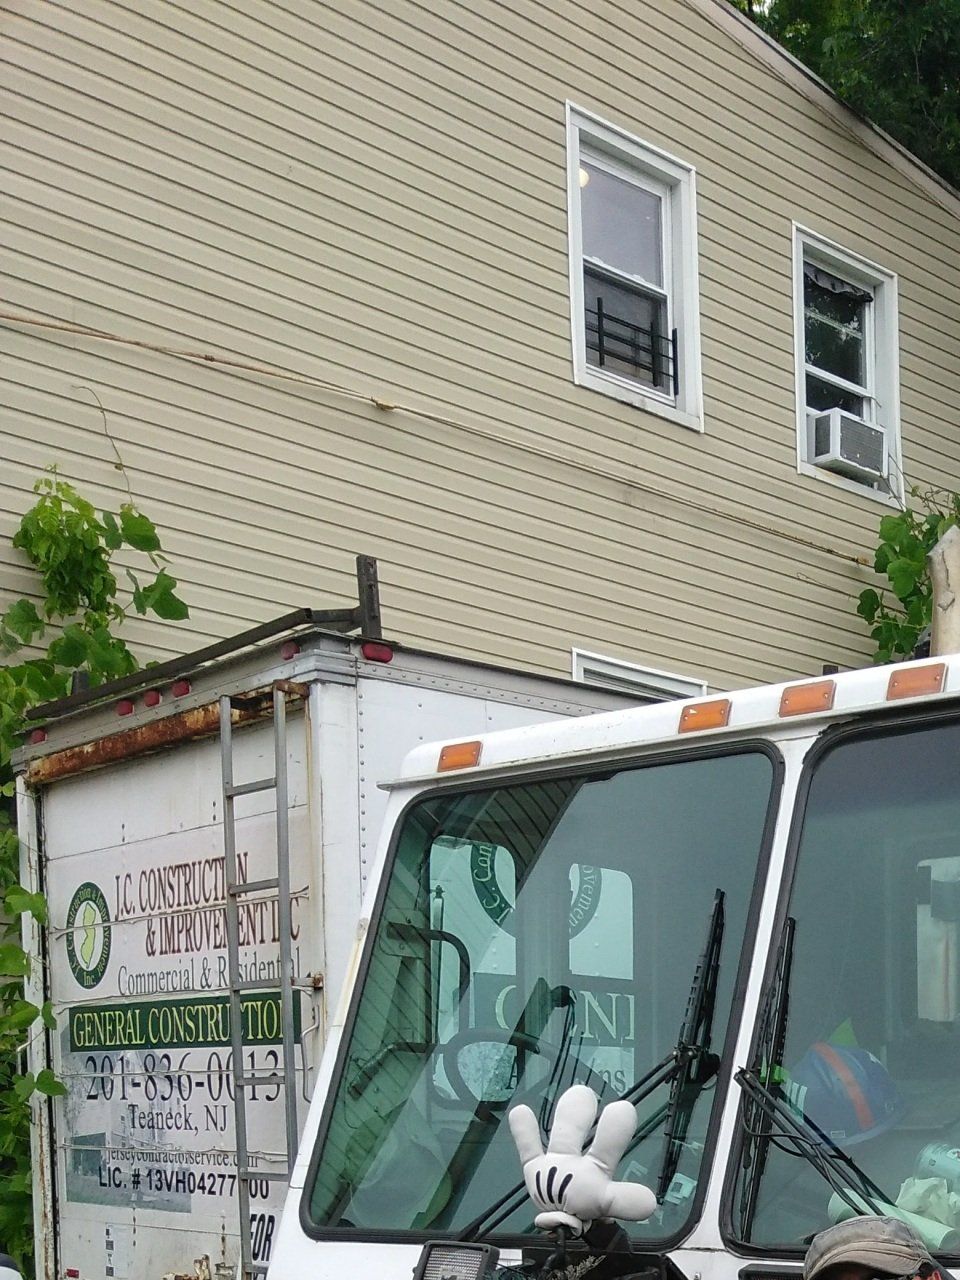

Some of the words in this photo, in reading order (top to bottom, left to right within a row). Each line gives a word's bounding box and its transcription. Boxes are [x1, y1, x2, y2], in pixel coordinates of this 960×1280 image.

[114, 873, 136, 922] J.C.
[138, 852, 248, 913] CONSTRUCTIN
[145, 918, 156, 957] &
[117, 958, 195, 996] Commercial
[199, 958, 212, 989] &
[73, 1007, 146, 1047] GENERAL
[128, 1104, 198, 1135] Teaneck,
[204, 1104, 228, 1132] NJ
[106, 1150, 258, 1168] jerseycontractorservice.cm
[99, 1166, 127, 1189] LIC.
[132, 1168, 141, 1190] #
[146, 1168, 269, 1200] 13VH0427700
